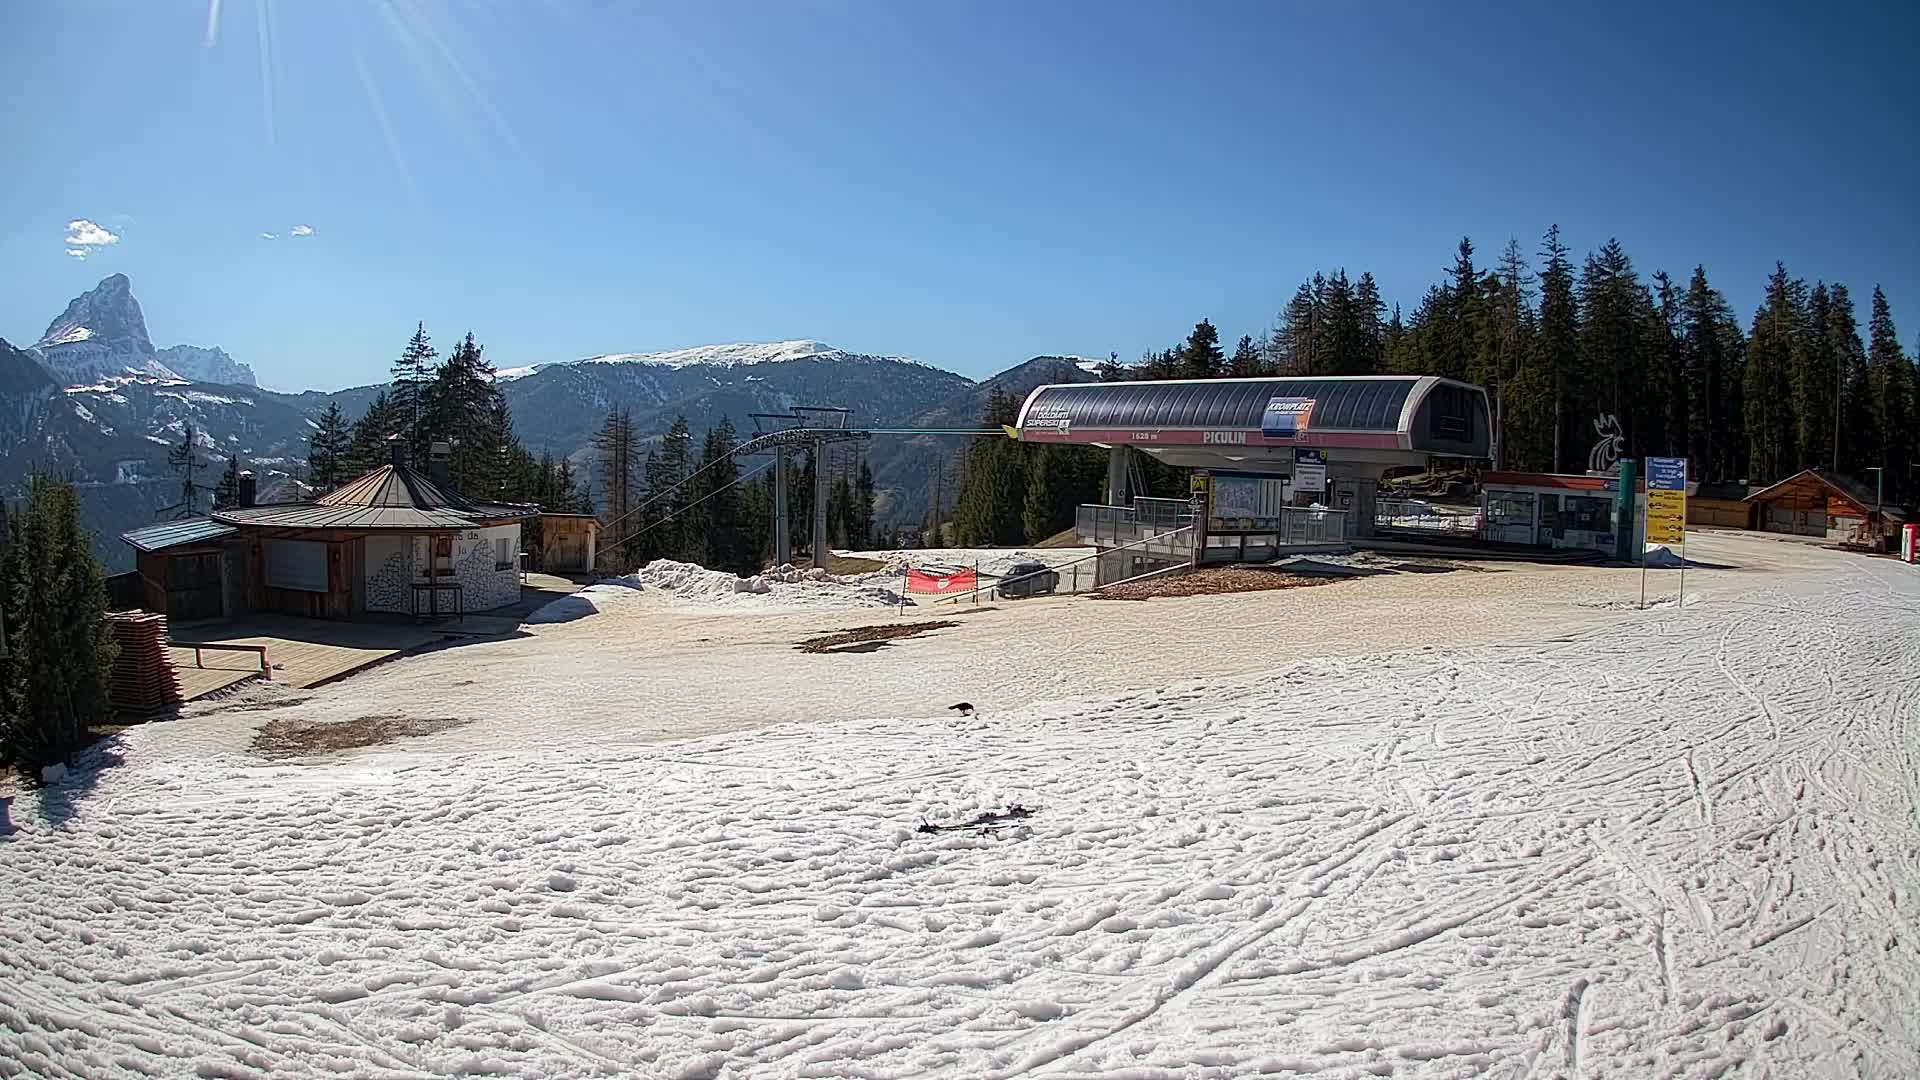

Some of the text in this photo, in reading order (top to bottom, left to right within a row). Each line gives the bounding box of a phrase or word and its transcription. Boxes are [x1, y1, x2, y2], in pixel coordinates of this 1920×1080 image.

[1267, 402, 1313, 411] KRONPLATZ
[1026, 419, 1059, 427] SUPERSKI
[1203, 431, 1247, 444] PICULIN
